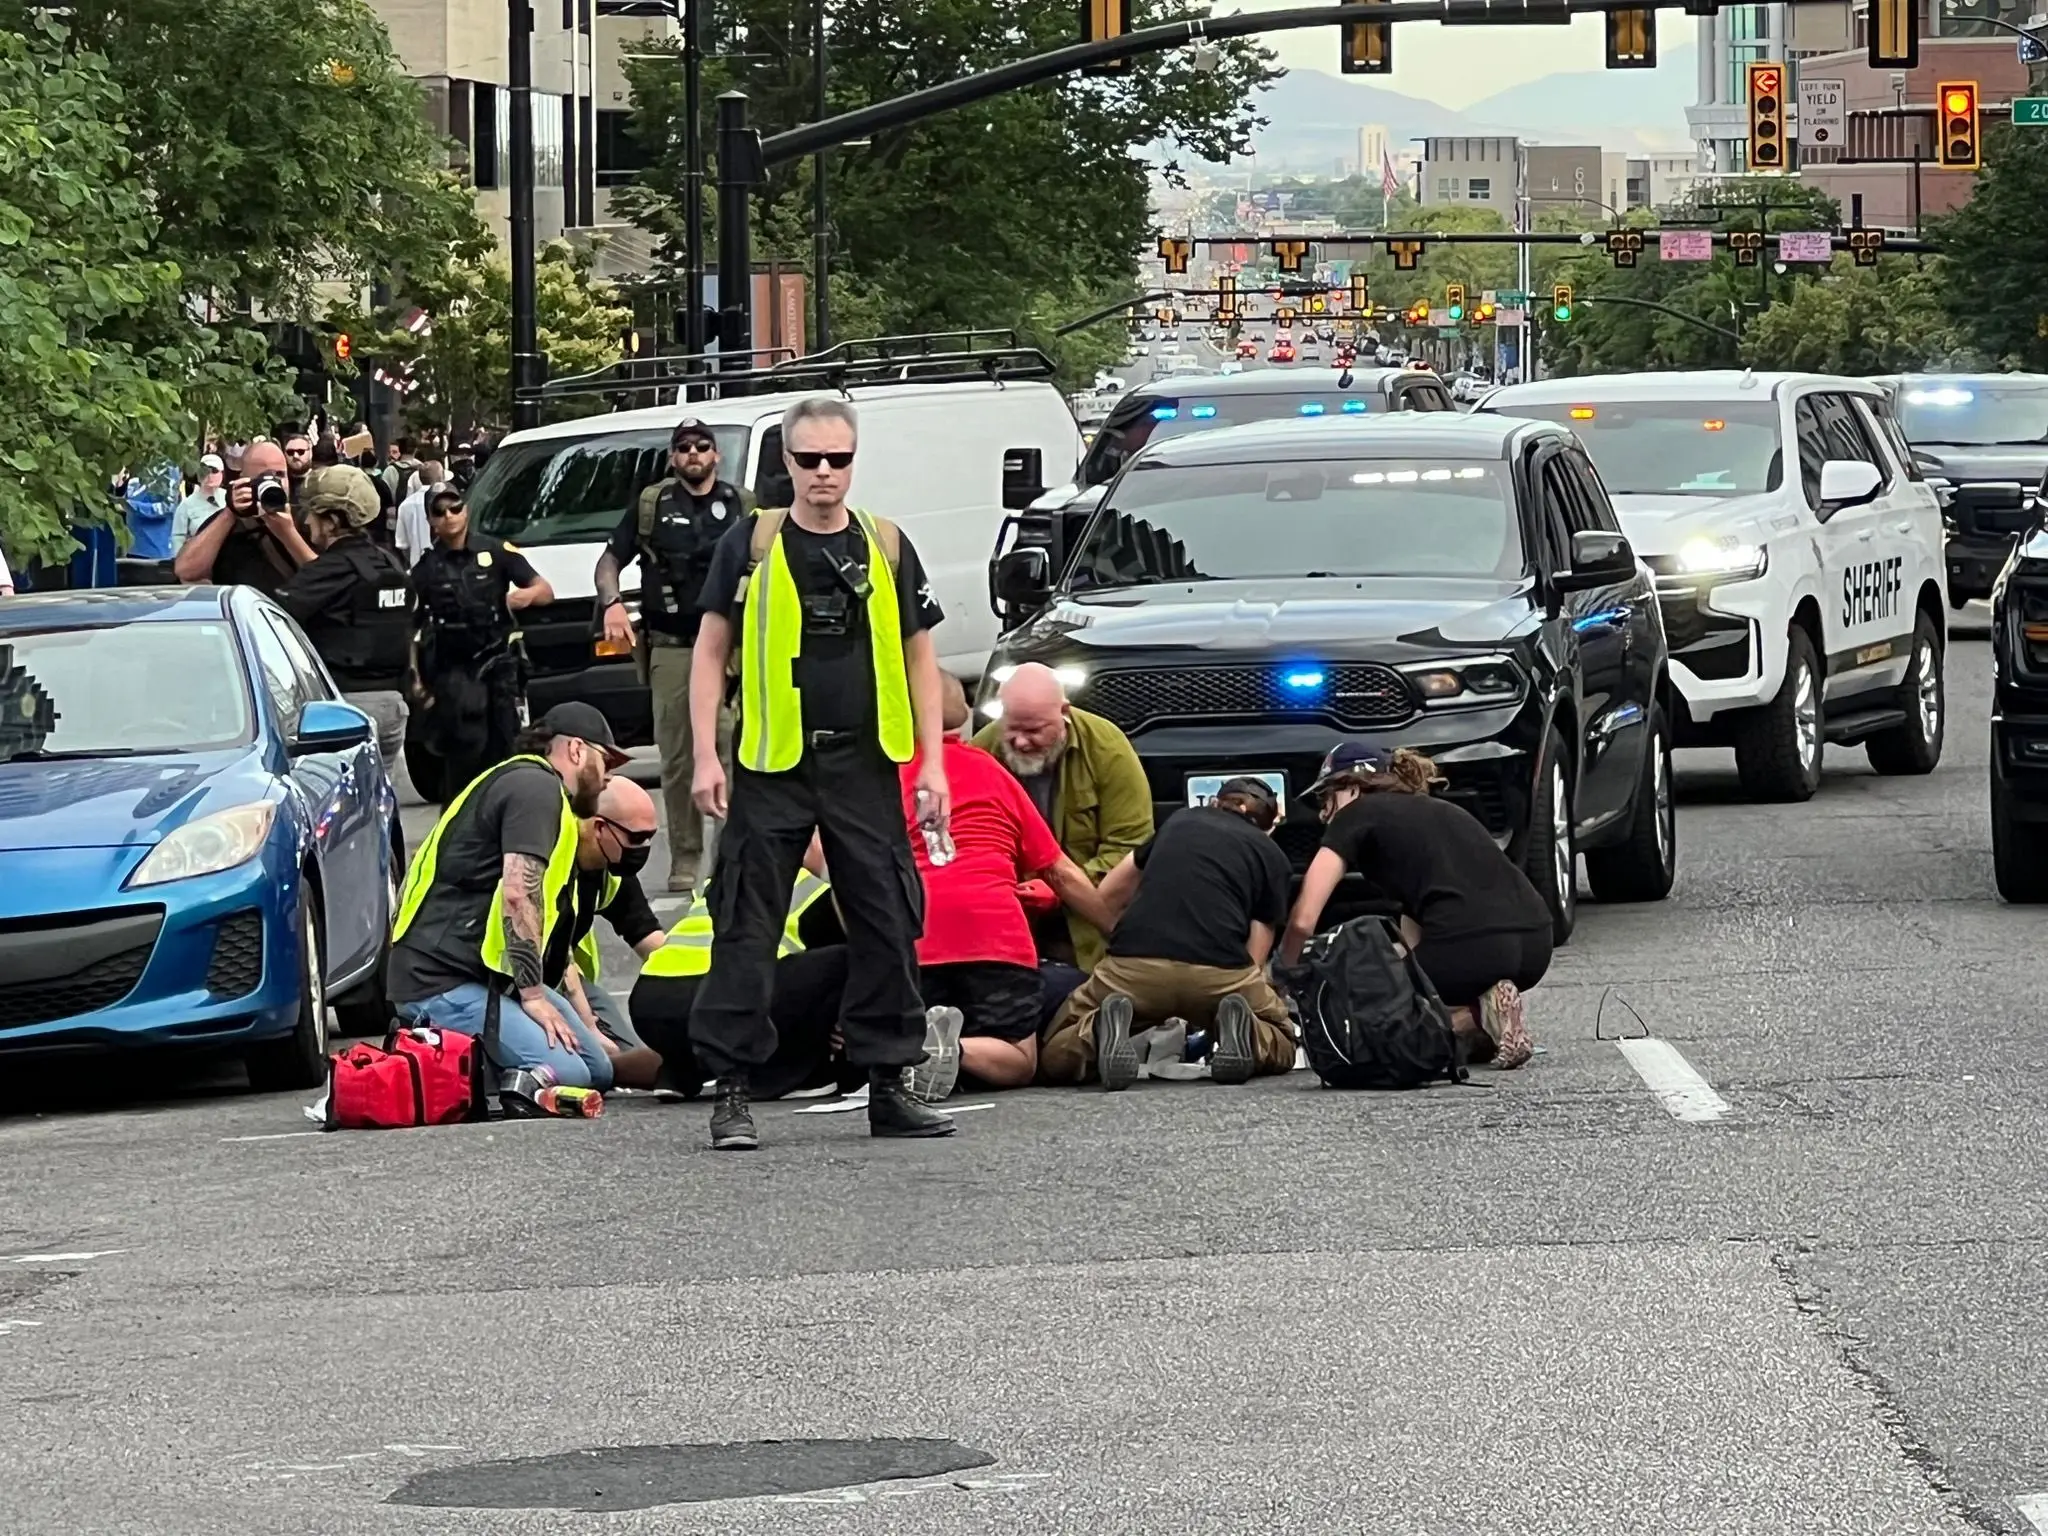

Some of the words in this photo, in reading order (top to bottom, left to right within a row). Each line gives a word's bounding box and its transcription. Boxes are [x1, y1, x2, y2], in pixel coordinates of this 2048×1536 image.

[1806, 93, 1837, 105] YIELD
[378, 587, 406, 608] POLICE
[1842, 556, 1902, 628] SHERIFF
